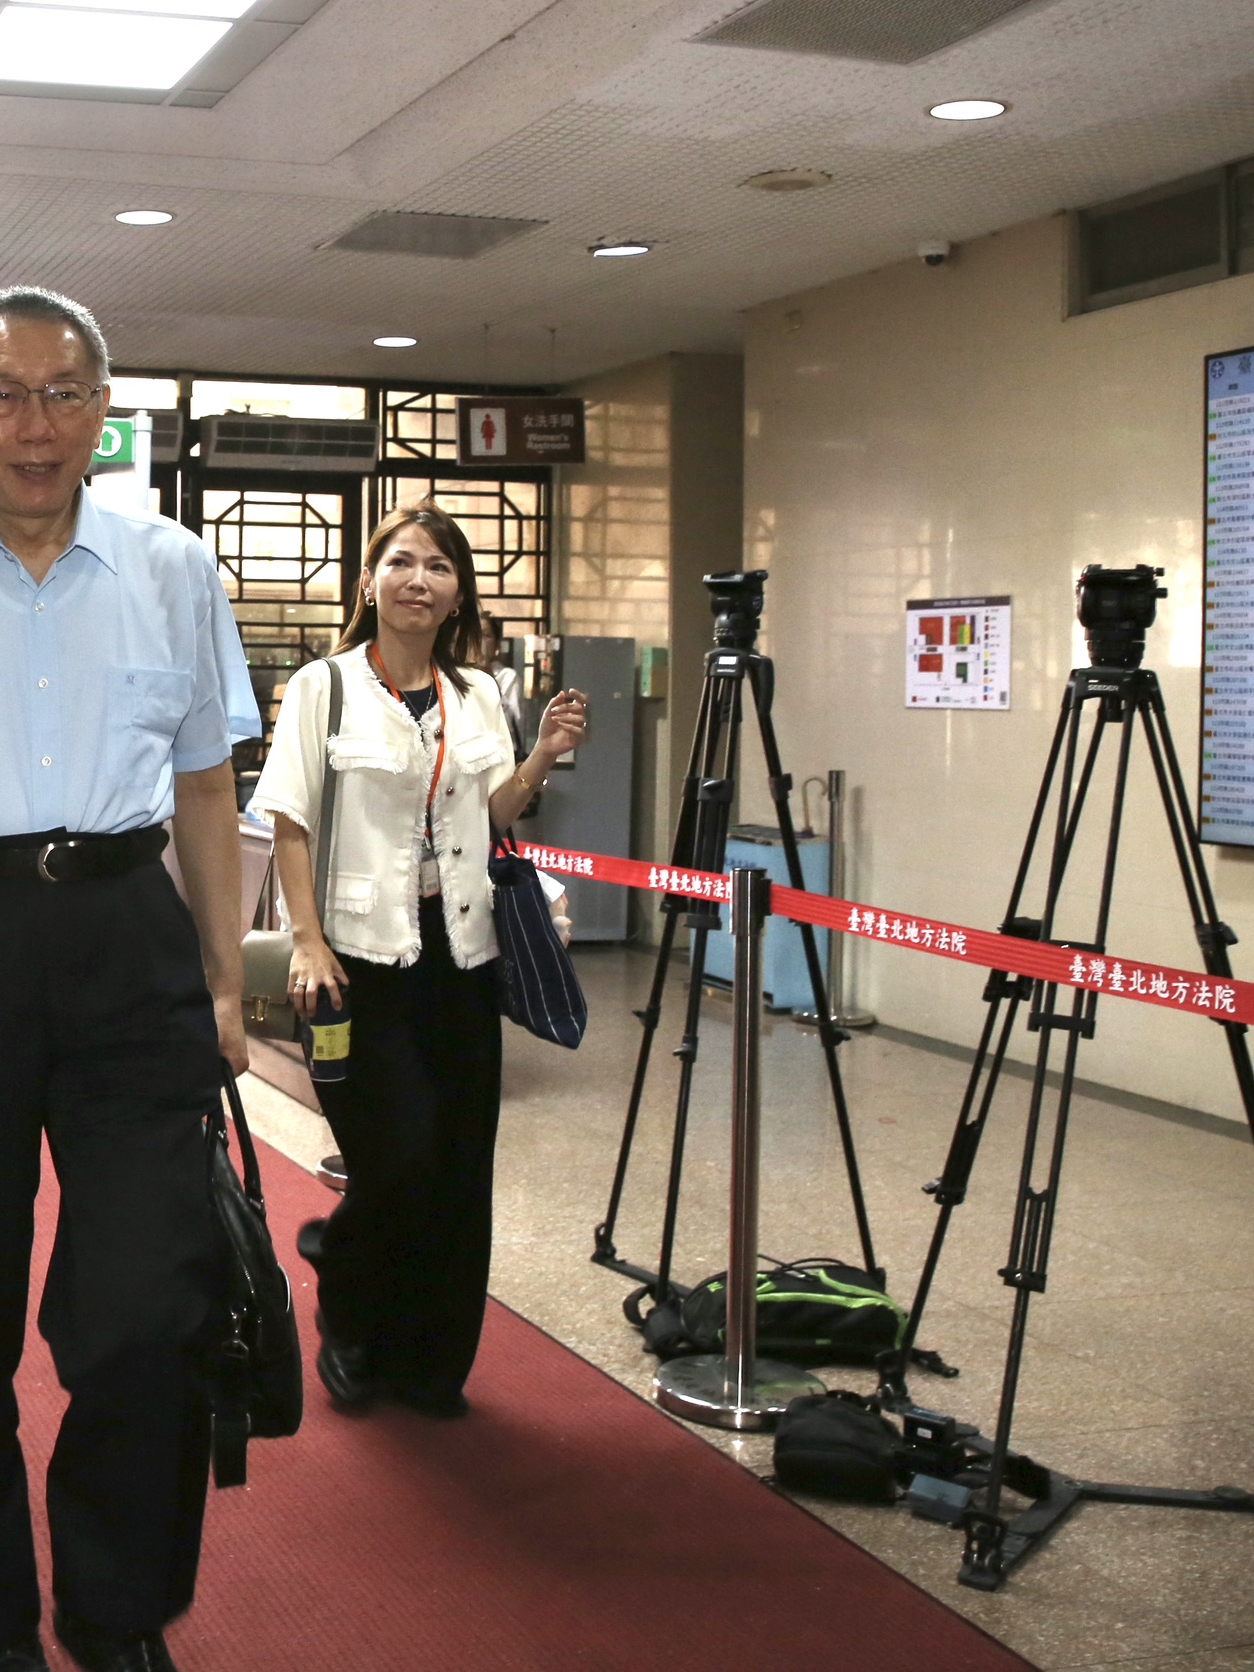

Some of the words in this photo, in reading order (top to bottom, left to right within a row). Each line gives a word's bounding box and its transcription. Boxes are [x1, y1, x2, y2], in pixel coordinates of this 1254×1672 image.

[523, 414, 575, 429] 女洗手間
[847, 907, 967, 955] 臺灣臺北地方法院
[1068, 954, 1236, 1013] 臺灣臺北地方法院
